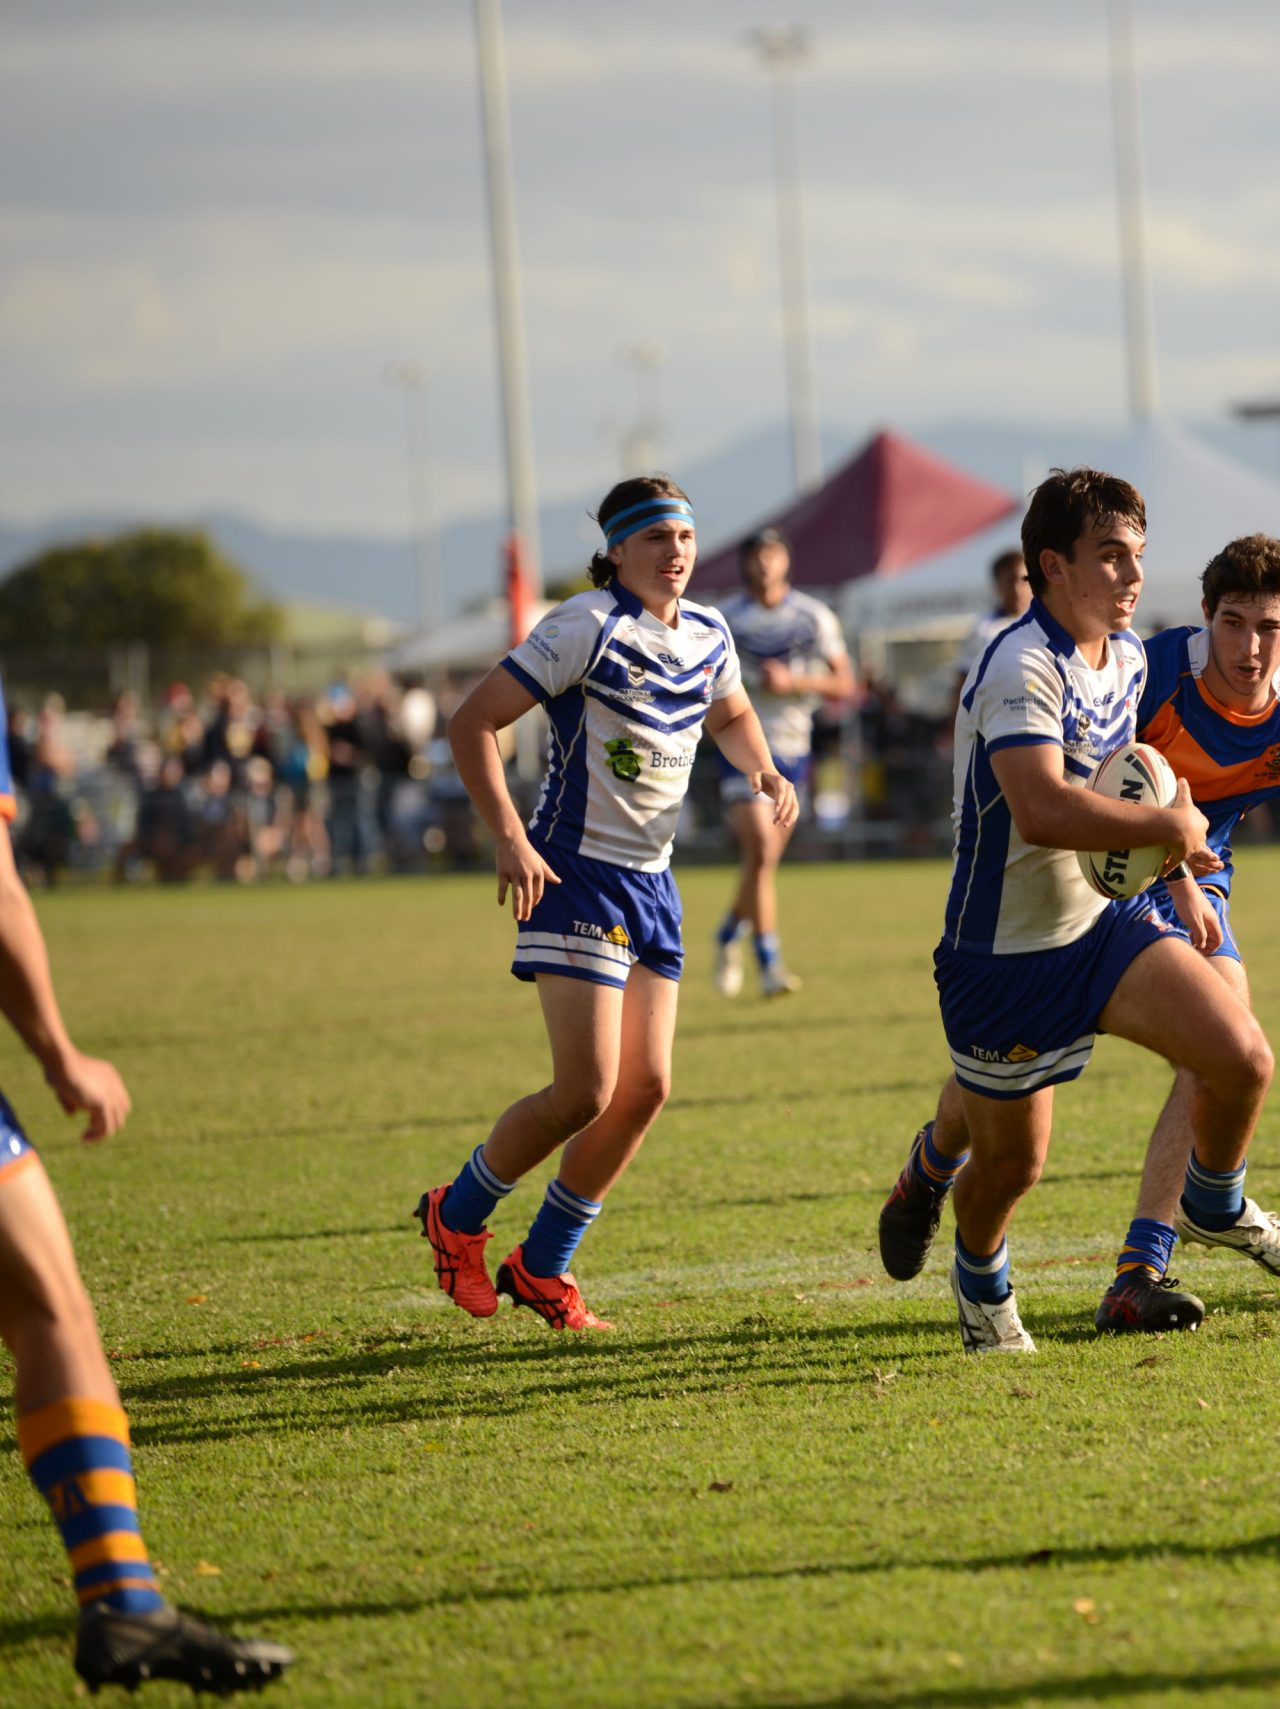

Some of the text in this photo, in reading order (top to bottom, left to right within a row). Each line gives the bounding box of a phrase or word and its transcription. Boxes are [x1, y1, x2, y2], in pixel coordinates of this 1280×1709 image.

[650, 748, 696, 768] Brothe
[572, 919, 603, 939] TEM
[970, 1044, 1000, 1062] TEM
